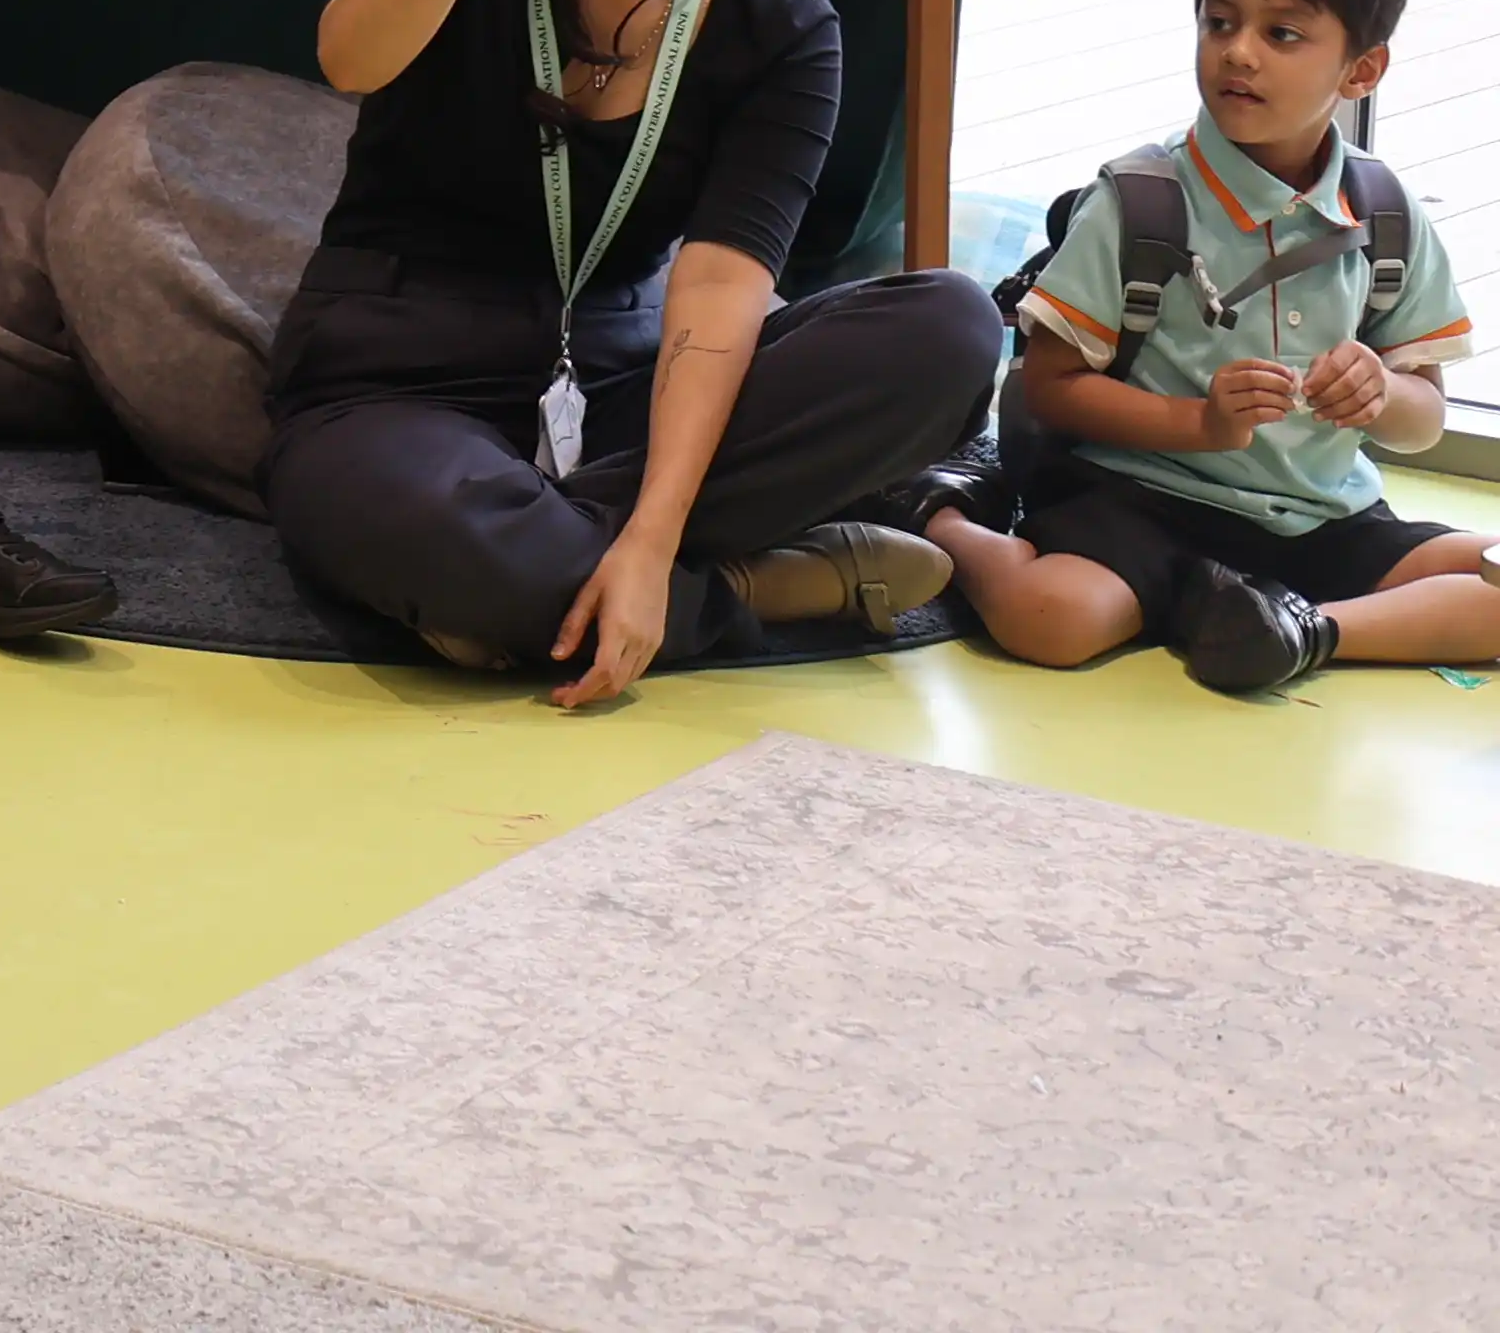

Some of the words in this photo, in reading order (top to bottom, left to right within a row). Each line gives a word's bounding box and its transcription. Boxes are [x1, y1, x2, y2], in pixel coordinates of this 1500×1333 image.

[536, 22, 554, 93] NATIONAL
[618, 149, 647, 203] COLLEGE
[642, 45, 679, 148] INTERNATIONAL
[671, 10, 689, 44] PUNE
